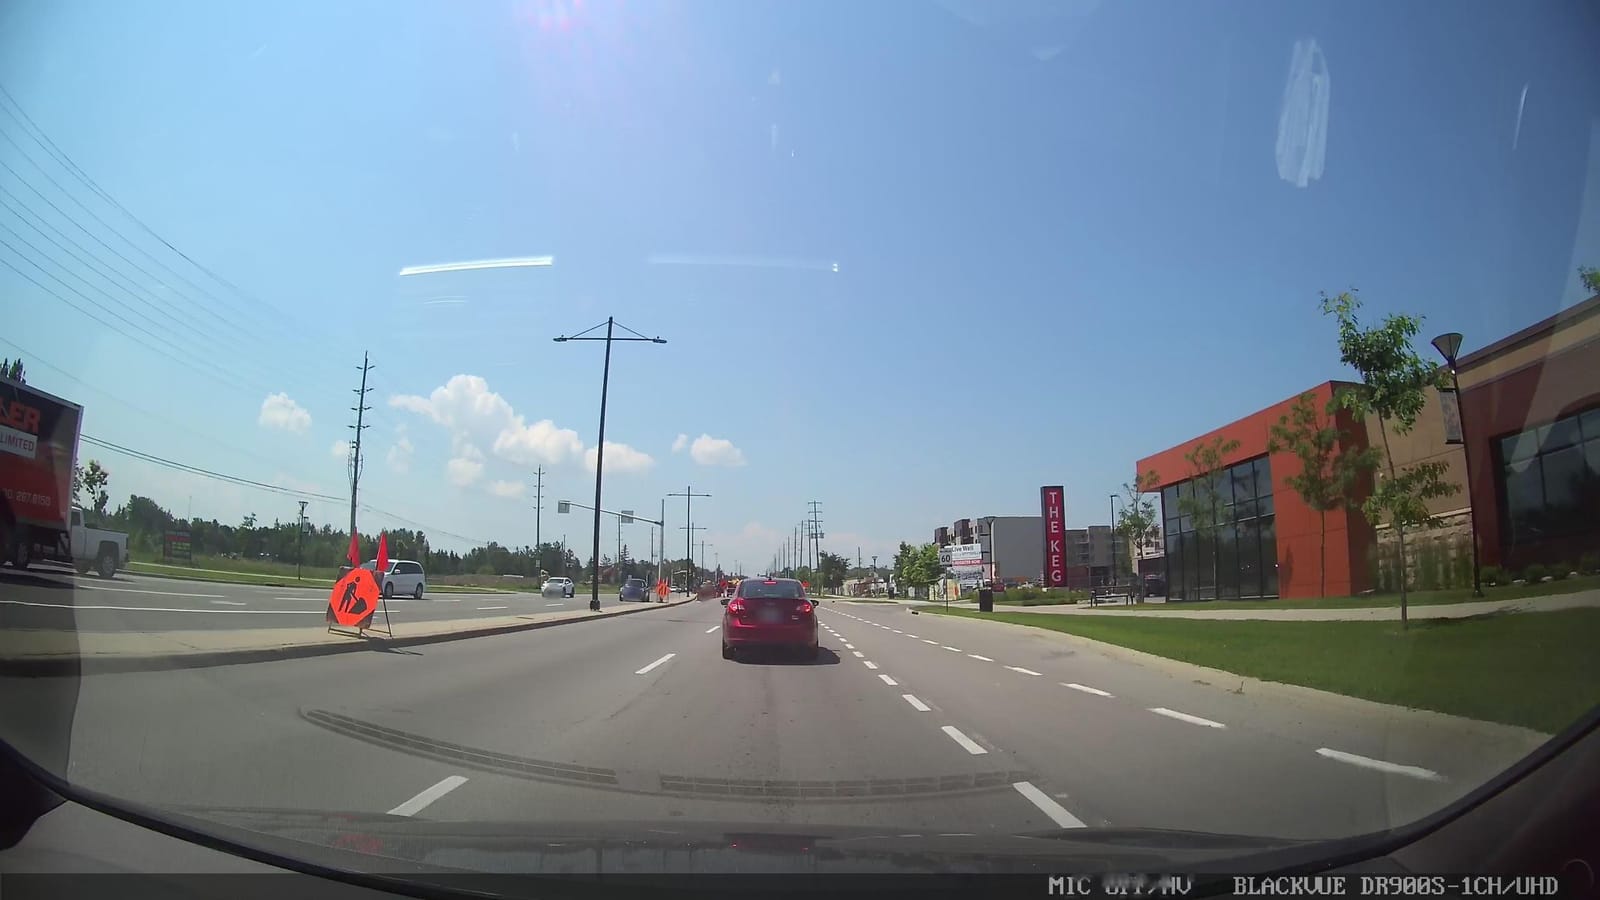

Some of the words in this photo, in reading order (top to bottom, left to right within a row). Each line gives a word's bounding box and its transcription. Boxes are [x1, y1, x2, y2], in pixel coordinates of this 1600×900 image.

[0, 433, 34, 451] LIMITED
[1049, 492, 1059, 533] THE
[941, 554, 951, 563] 60
[1051, 540, 1062, 582] KEG
